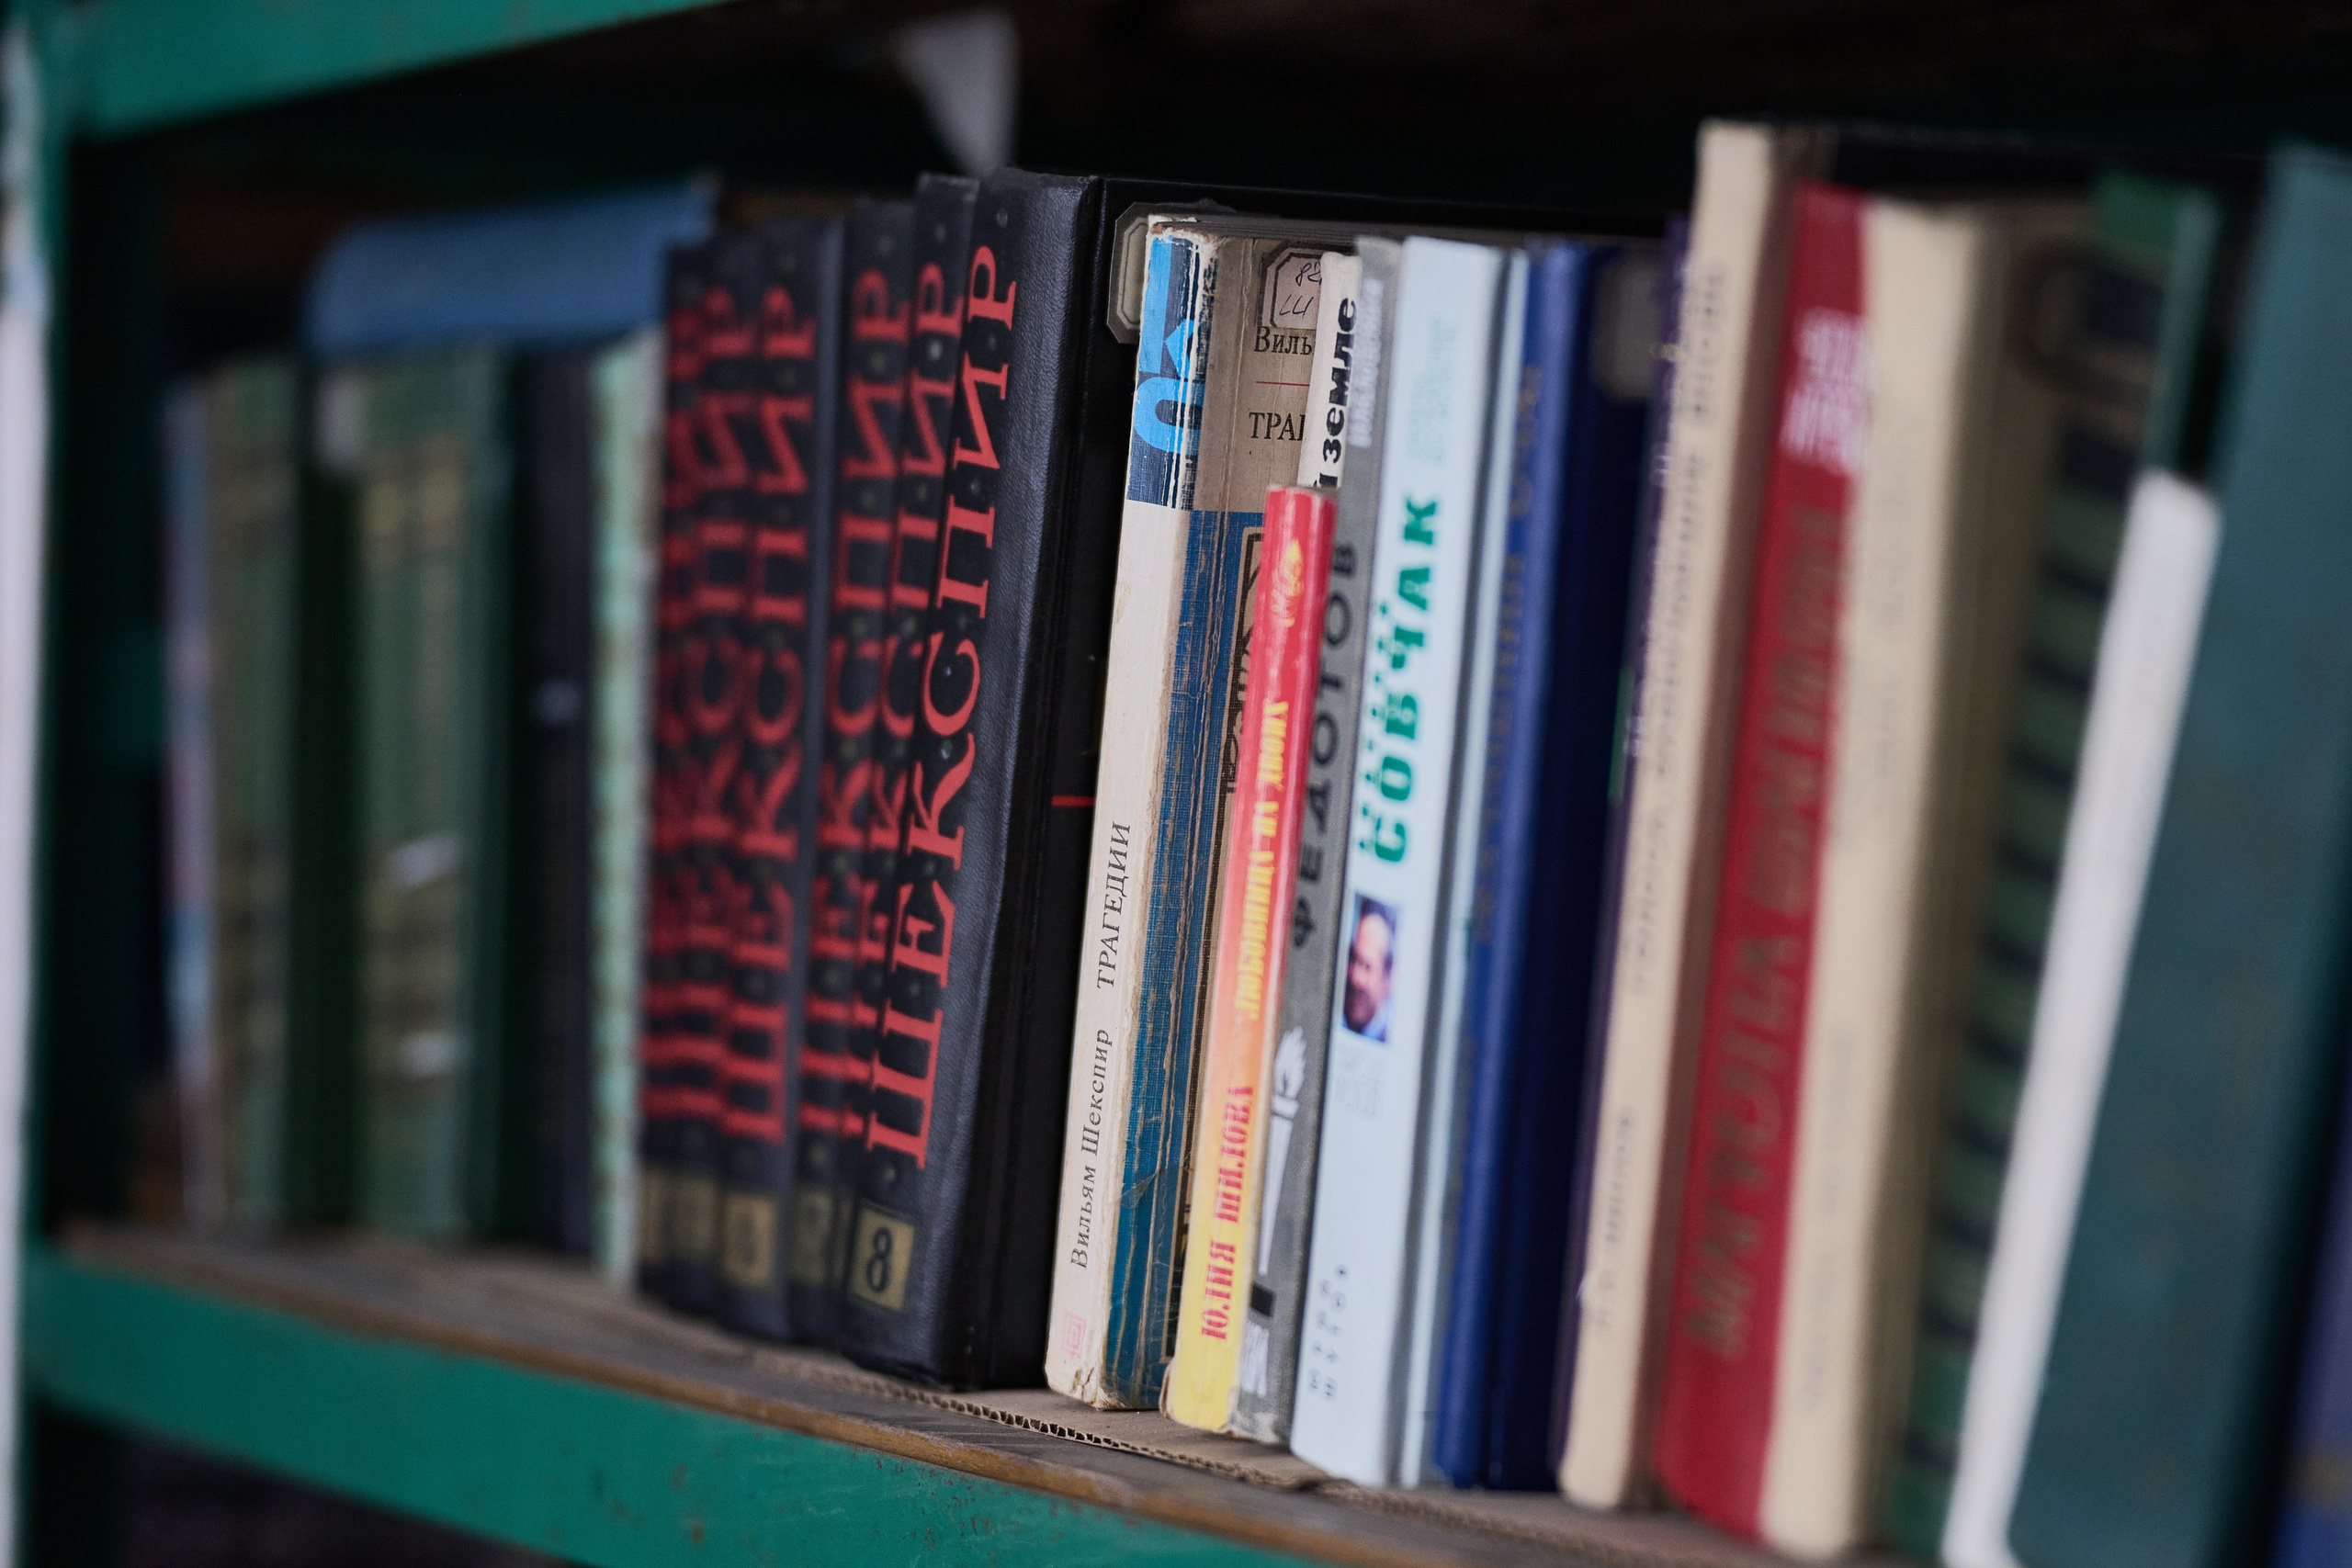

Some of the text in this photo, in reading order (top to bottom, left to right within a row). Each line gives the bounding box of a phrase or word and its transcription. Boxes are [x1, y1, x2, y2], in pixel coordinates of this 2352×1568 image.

[1254, 325, 1315, 355] Виль
[1321, 298, 1358, 464] земле
[866, 245, 1017, 1169] ШЕКСПИР
[1374, 496, 1439, 863] СОБЧАК
[1070, 821, 1131, 1269] Вильям Шекспир ТРАГЕДИИ
[866, 1226, 894, 1294] 8
[1201, 1086, 1254, 1340] ЮЛИЯ ШИЛОВА
